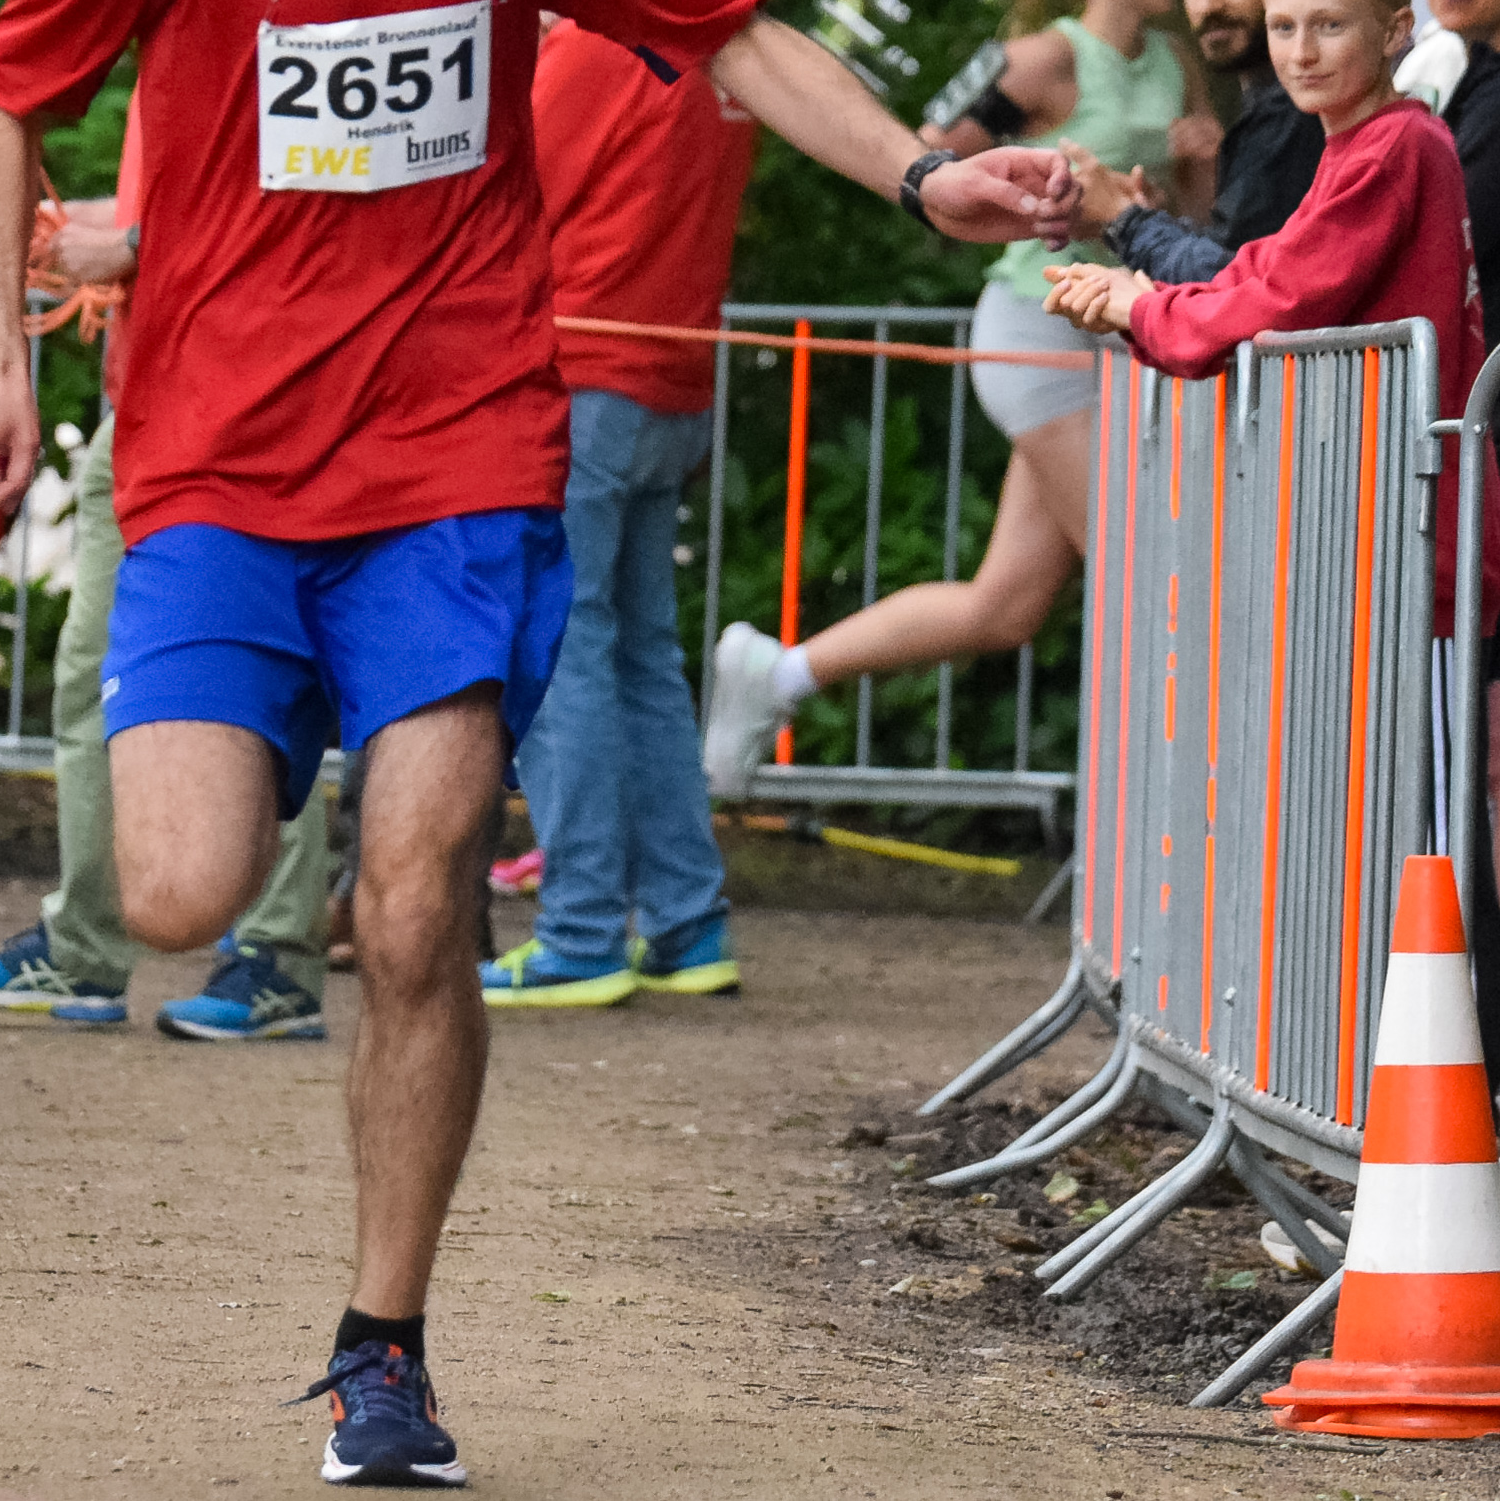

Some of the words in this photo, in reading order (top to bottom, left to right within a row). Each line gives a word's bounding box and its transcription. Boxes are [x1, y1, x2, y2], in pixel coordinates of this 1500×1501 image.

[377, 15, 478, 45] Brunnenlauf
[268, 36, 474, 120] 2651
[348, 119, 414, 139] Hendrik
[285, 145, 373, 175] EWE
[407, 130, 470, 163] bruns
